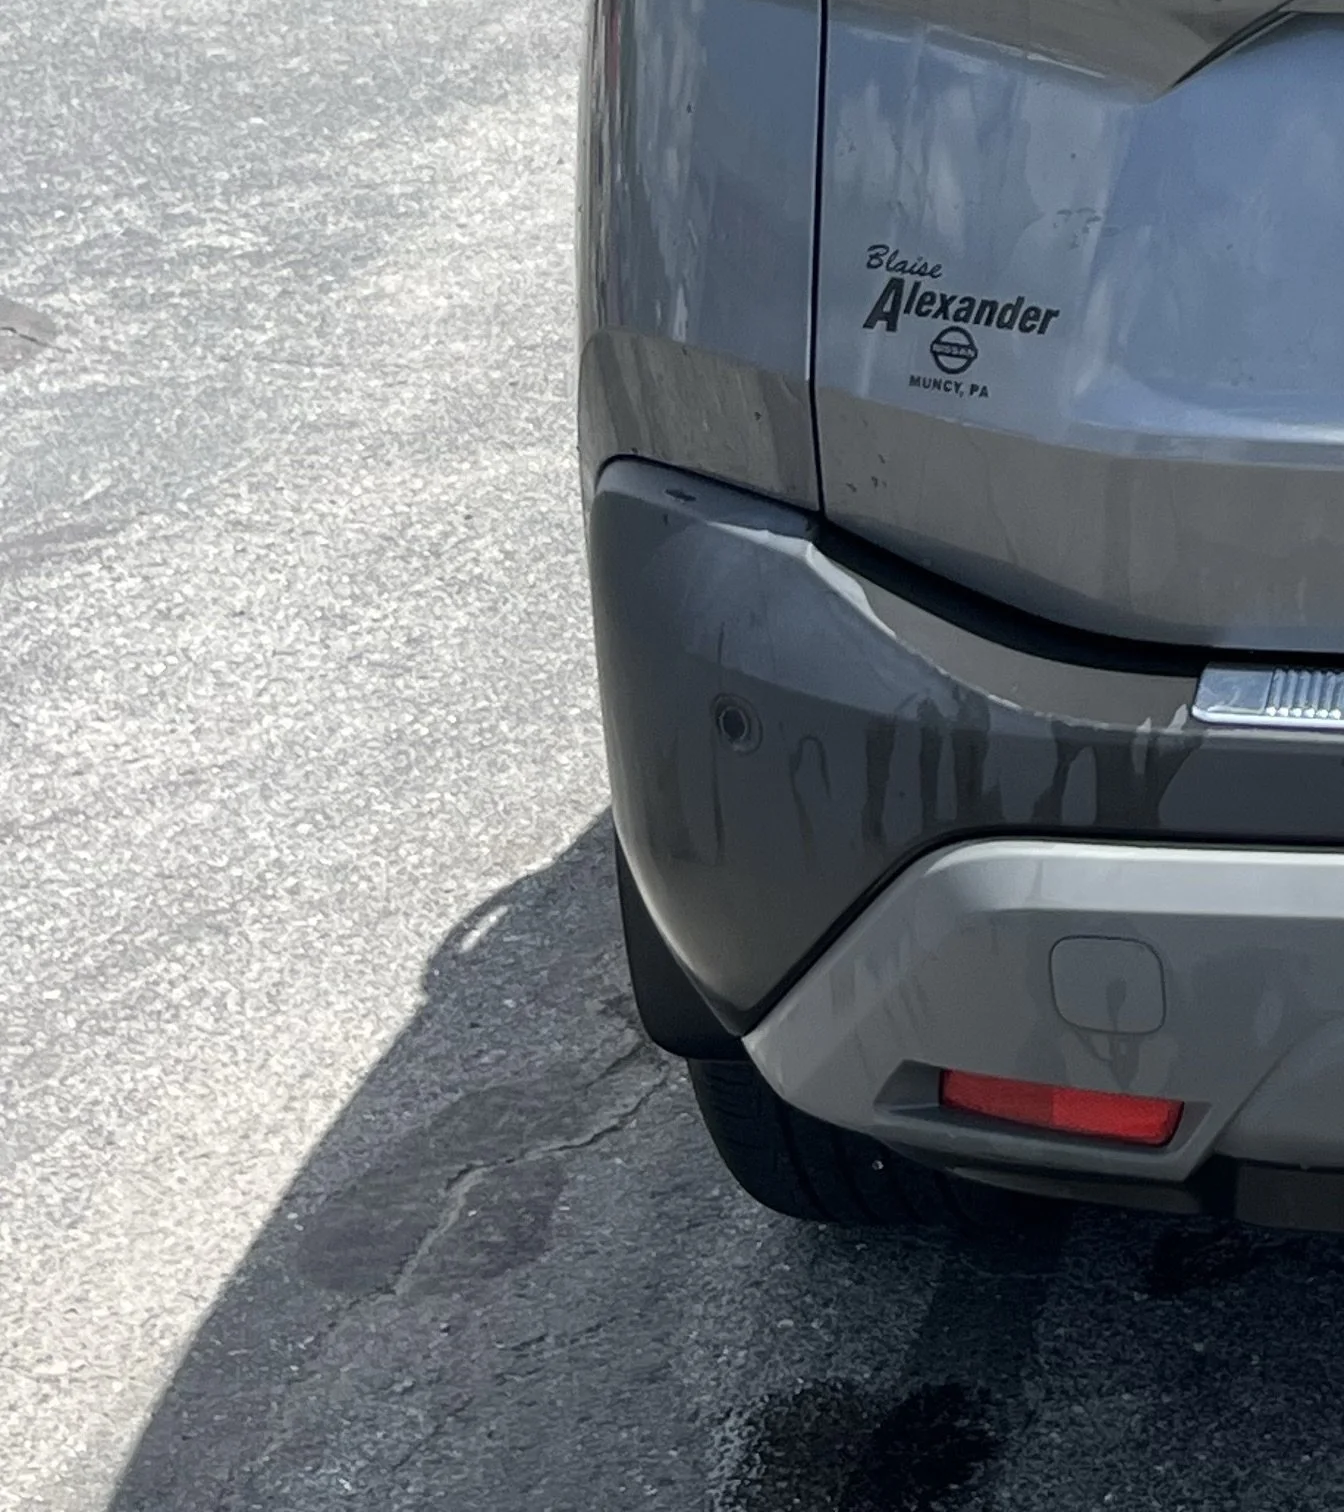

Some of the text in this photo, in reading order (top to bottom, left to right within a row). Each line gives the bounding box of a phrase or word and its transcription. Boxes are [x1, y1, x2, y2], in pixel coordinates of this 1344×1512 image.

[866, 243, 943, 279] Blaise
[862, 276, 1060, 335] Alexander
[908, 374, 990, 399] MUNCY, PA
